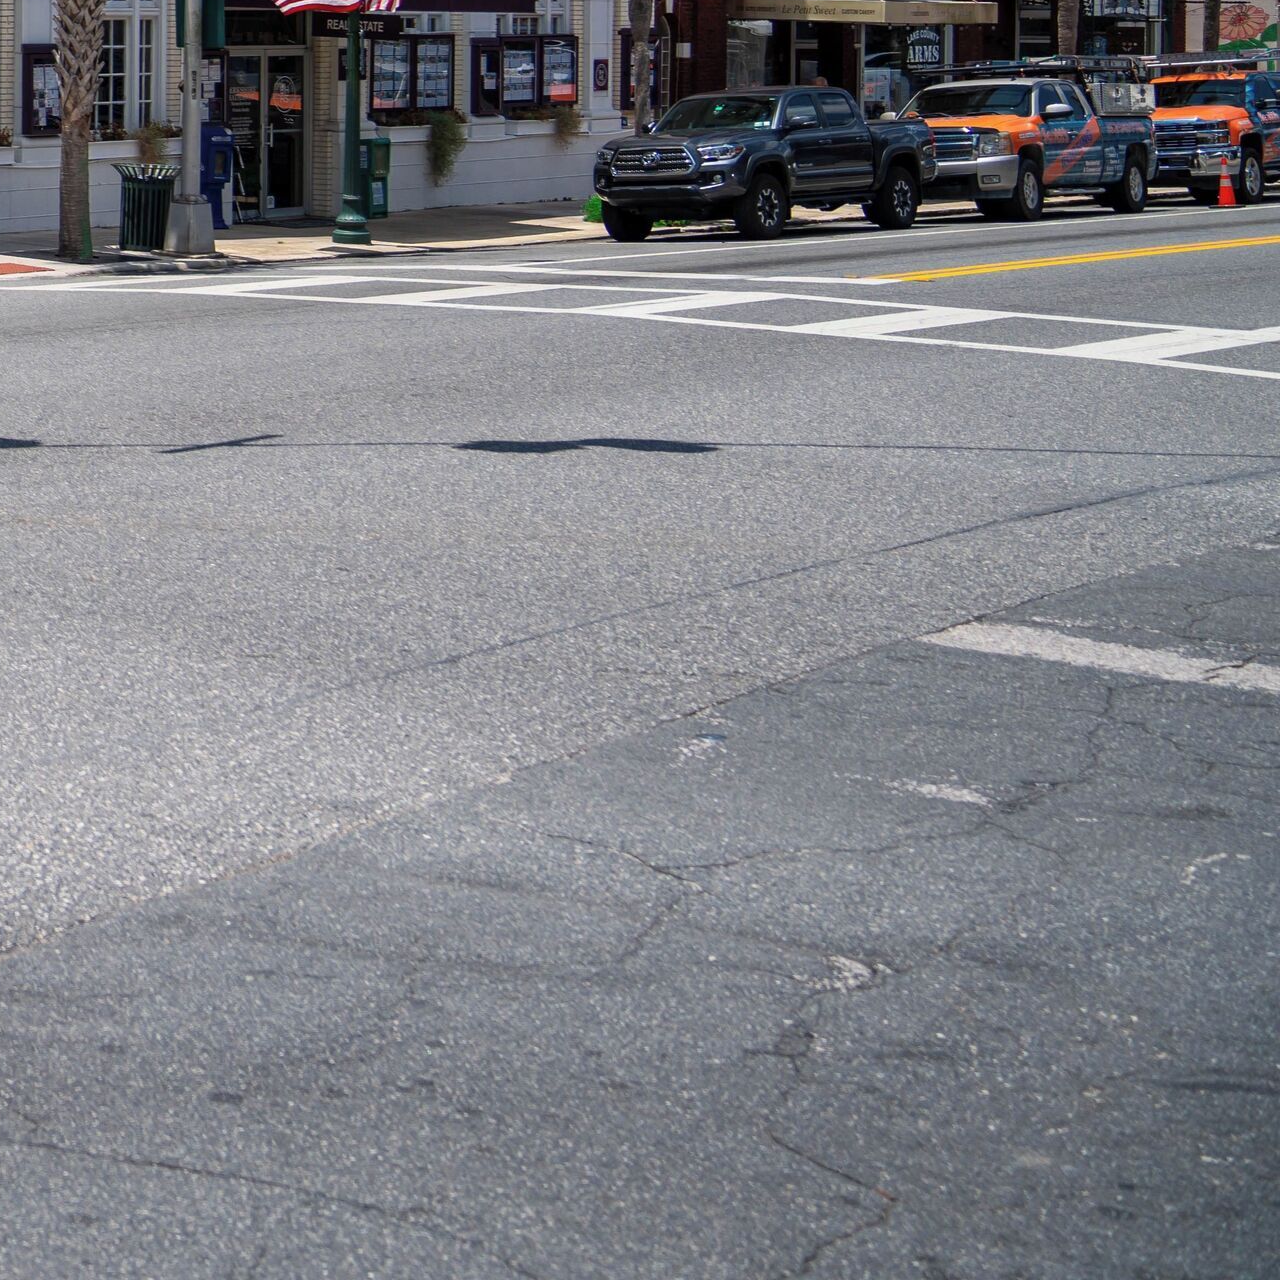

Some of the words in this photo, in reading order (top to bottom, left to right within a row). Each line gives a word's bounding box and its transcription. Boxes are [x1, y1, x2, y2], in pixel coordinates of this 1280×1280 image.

[781, 3, 792, 14] Le
[793, 3, 812, 15] Petit
[813, 4, 836, 16] Sweet
[326, 19, 349, 30] REAL
[906, 30, 920, 43] LAKE
[919, 30, 940, 42] COUNTY
[906, 45, 940, 63] ARMS
